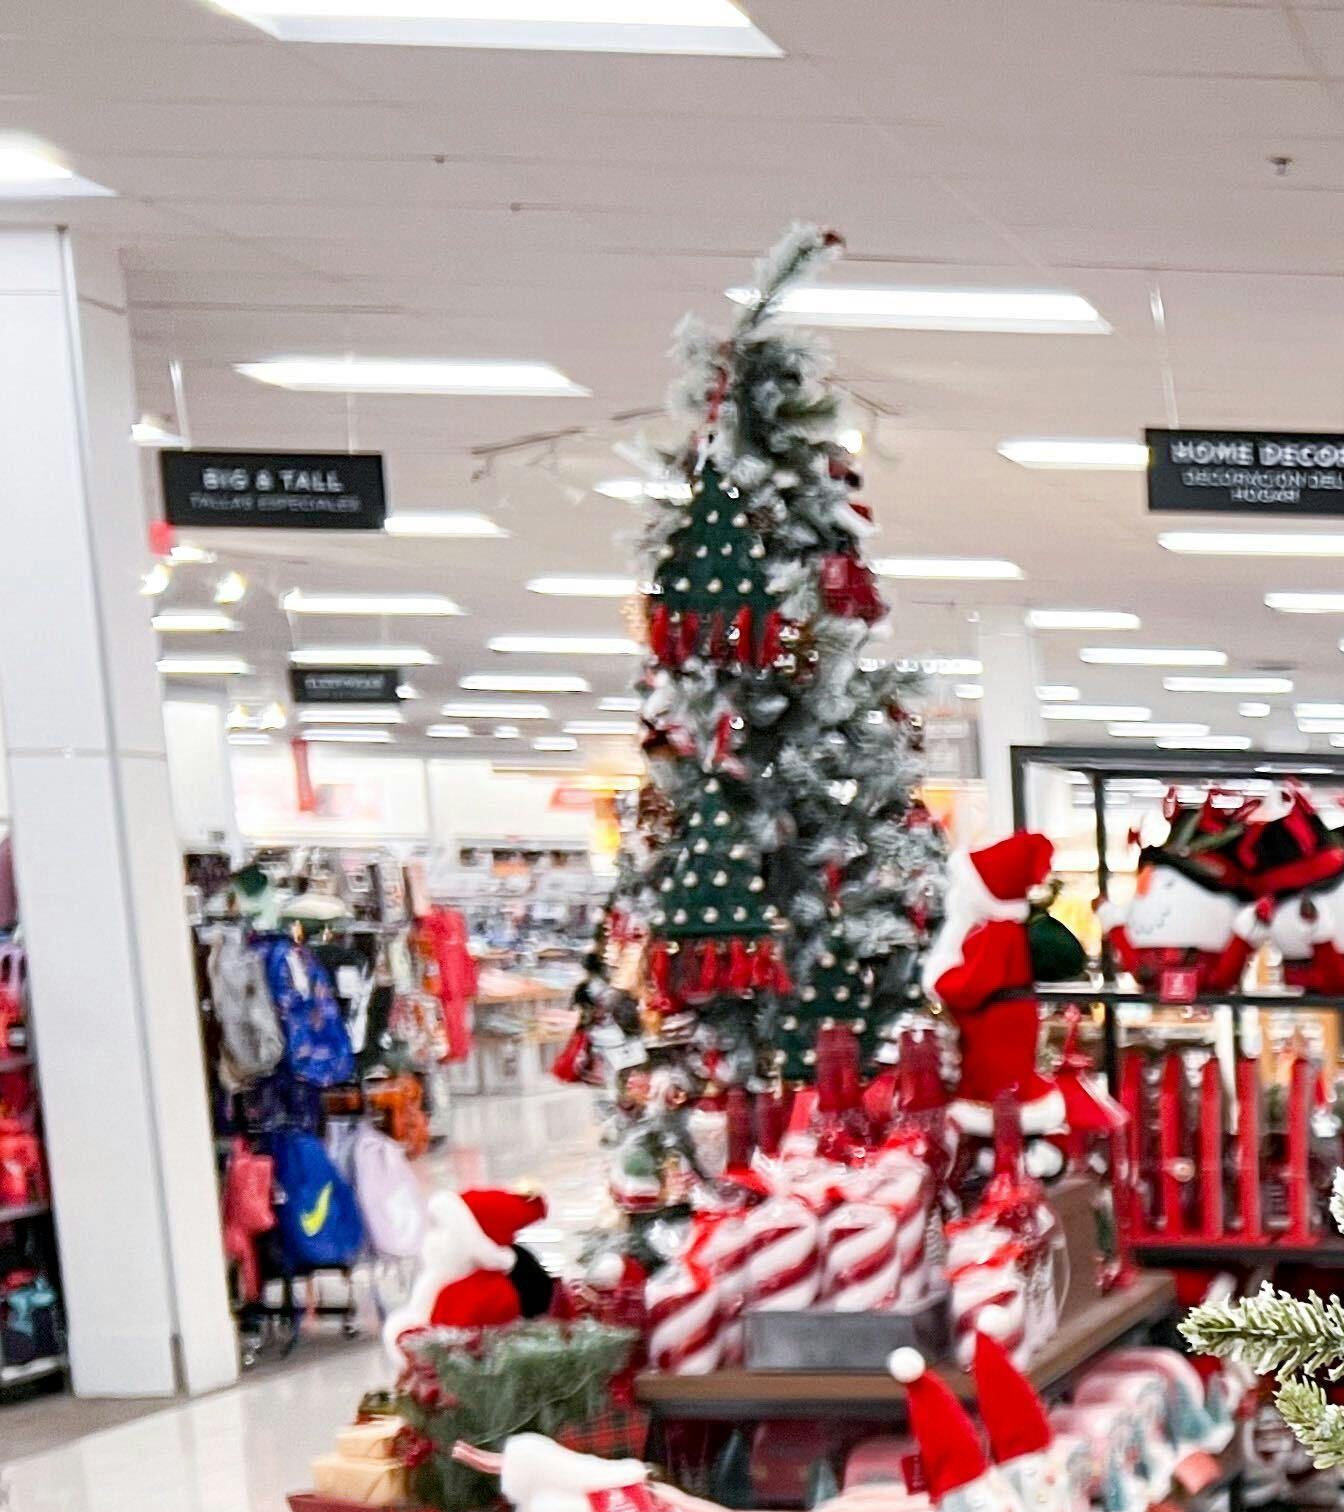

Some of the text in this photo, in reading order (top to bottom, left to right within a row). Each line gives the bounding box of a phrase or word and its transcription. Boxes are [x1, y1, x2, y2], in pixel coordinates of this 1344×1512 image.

[1171, 441, 1254, 464] HOME
[202, 467, 344, 493] BIG & TALL
